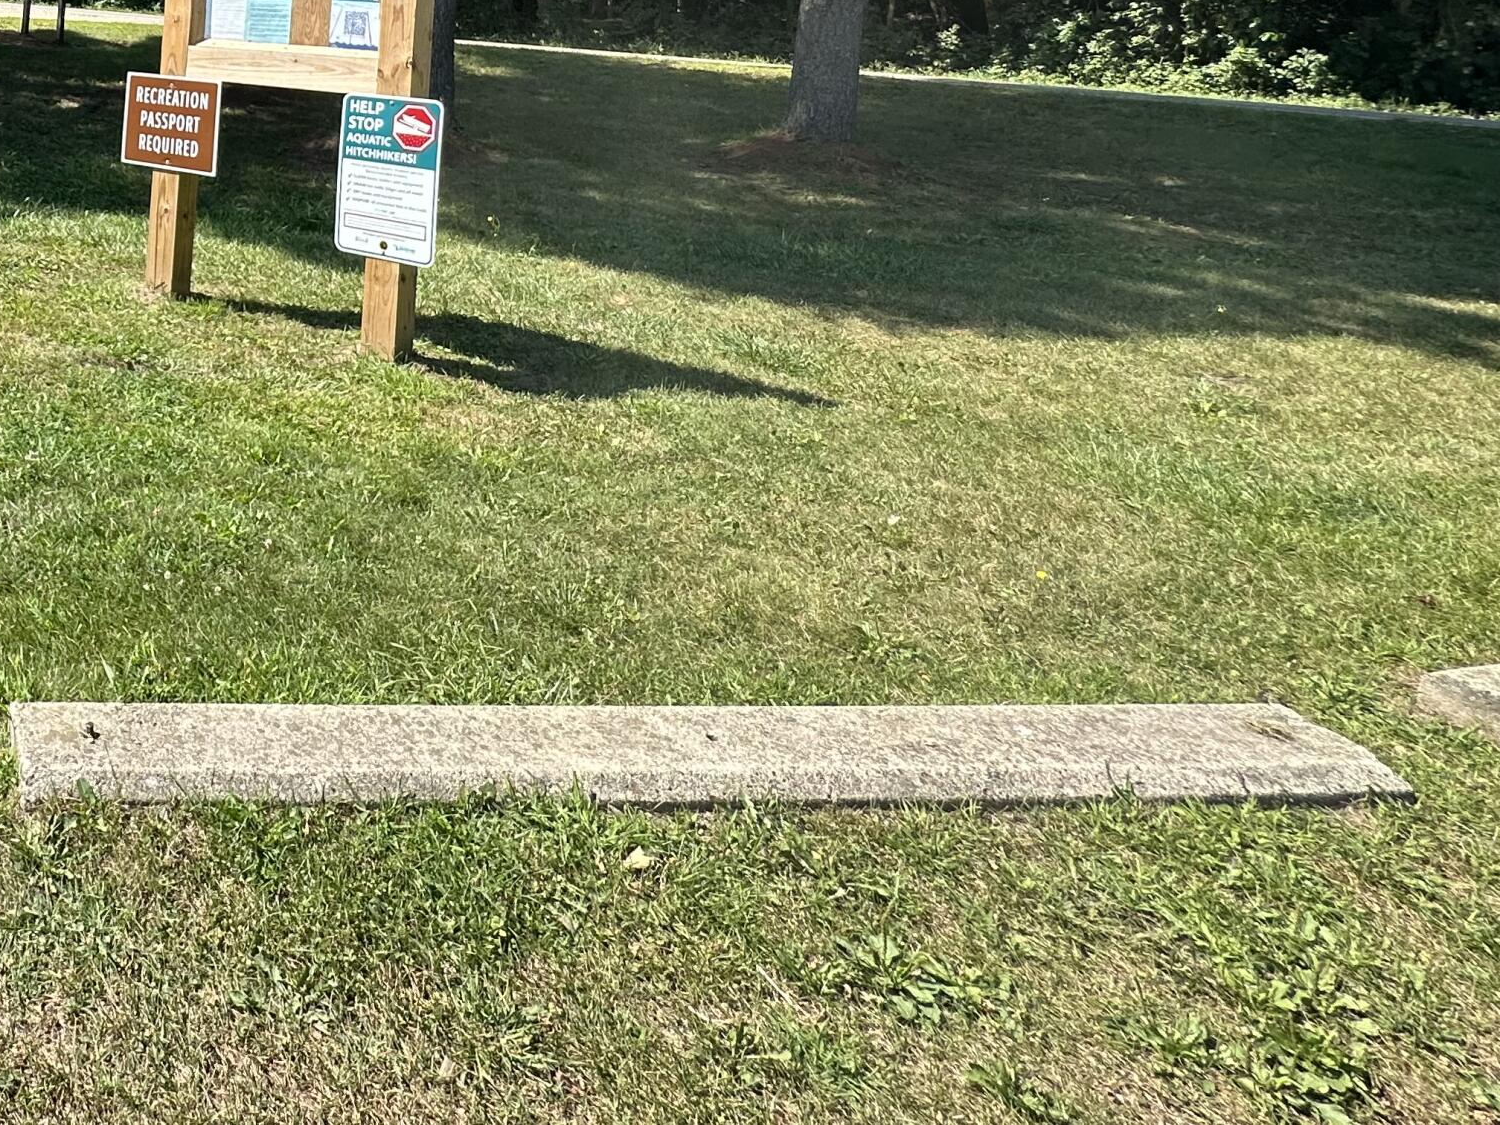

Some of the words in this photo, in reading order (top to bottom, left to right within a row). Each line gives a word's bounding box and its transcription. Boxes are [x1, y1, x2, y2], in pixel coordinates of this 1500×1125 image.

[135, 85, 209, 110] RECREATION
[349, 98, 385, 115] HELP
[140, 109, 201, 134] PASSPORT
[348, 115, 385, 132] STOP
[138, 133, 199, 158] REQUIRED
[346, 132, 392, 148] AQUATIC
[345, 145, 417, 165] HITCHHIKERS!
